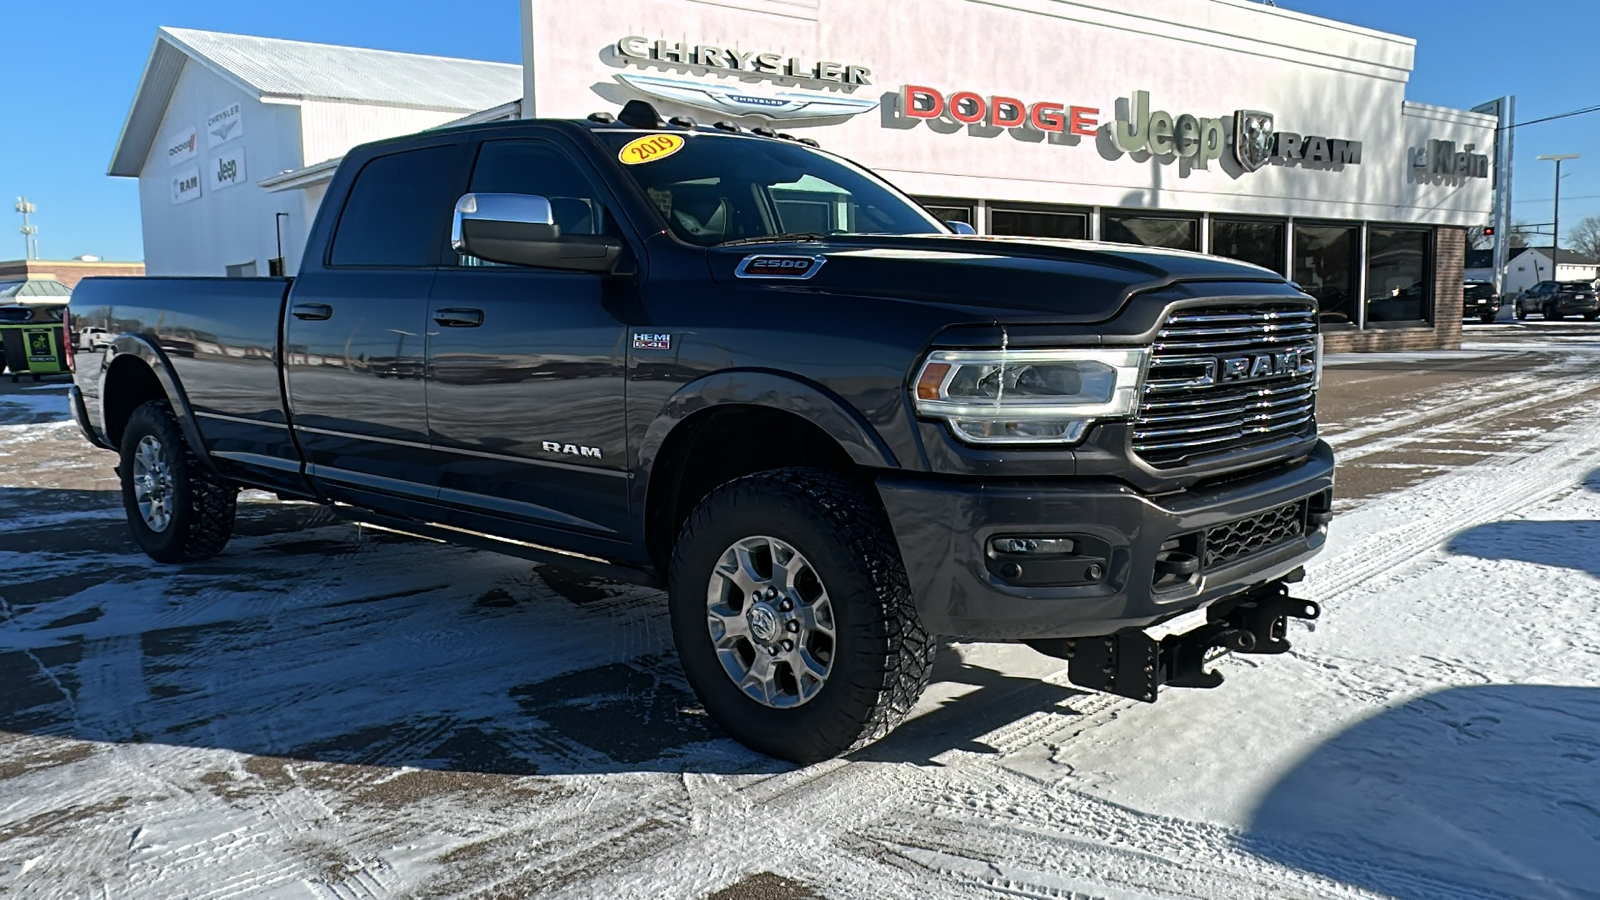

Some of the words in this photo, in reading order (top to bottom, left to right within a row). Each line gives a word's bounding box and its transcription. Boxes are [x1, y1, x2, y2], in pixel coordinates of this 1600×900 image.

[617, 35, 873, 86] CHRYSLER
[732, 96, 784, 105] CHRYSLER
[905, 84, 1100, 137] DODGE
[207, 105, 239, 126] CHRYSLER
[1115, 90, 1225, 170] Jeep
[169, 139, 191, 156] DODGE
[631, 136, 674, 160] 2019
[1276, 132, 1362, 164] RAM
[1427, 139, 1489, 178] Klein
[217, 158, 237, 183] Jeep
[179, 176, 198, 194] RAM
[753, 259, 808, 269] 2500
[633, 333, 670, 341] HEMI
[1223, 351, 1302, 382] RAM
[542, 441, 602, 460] RAM
